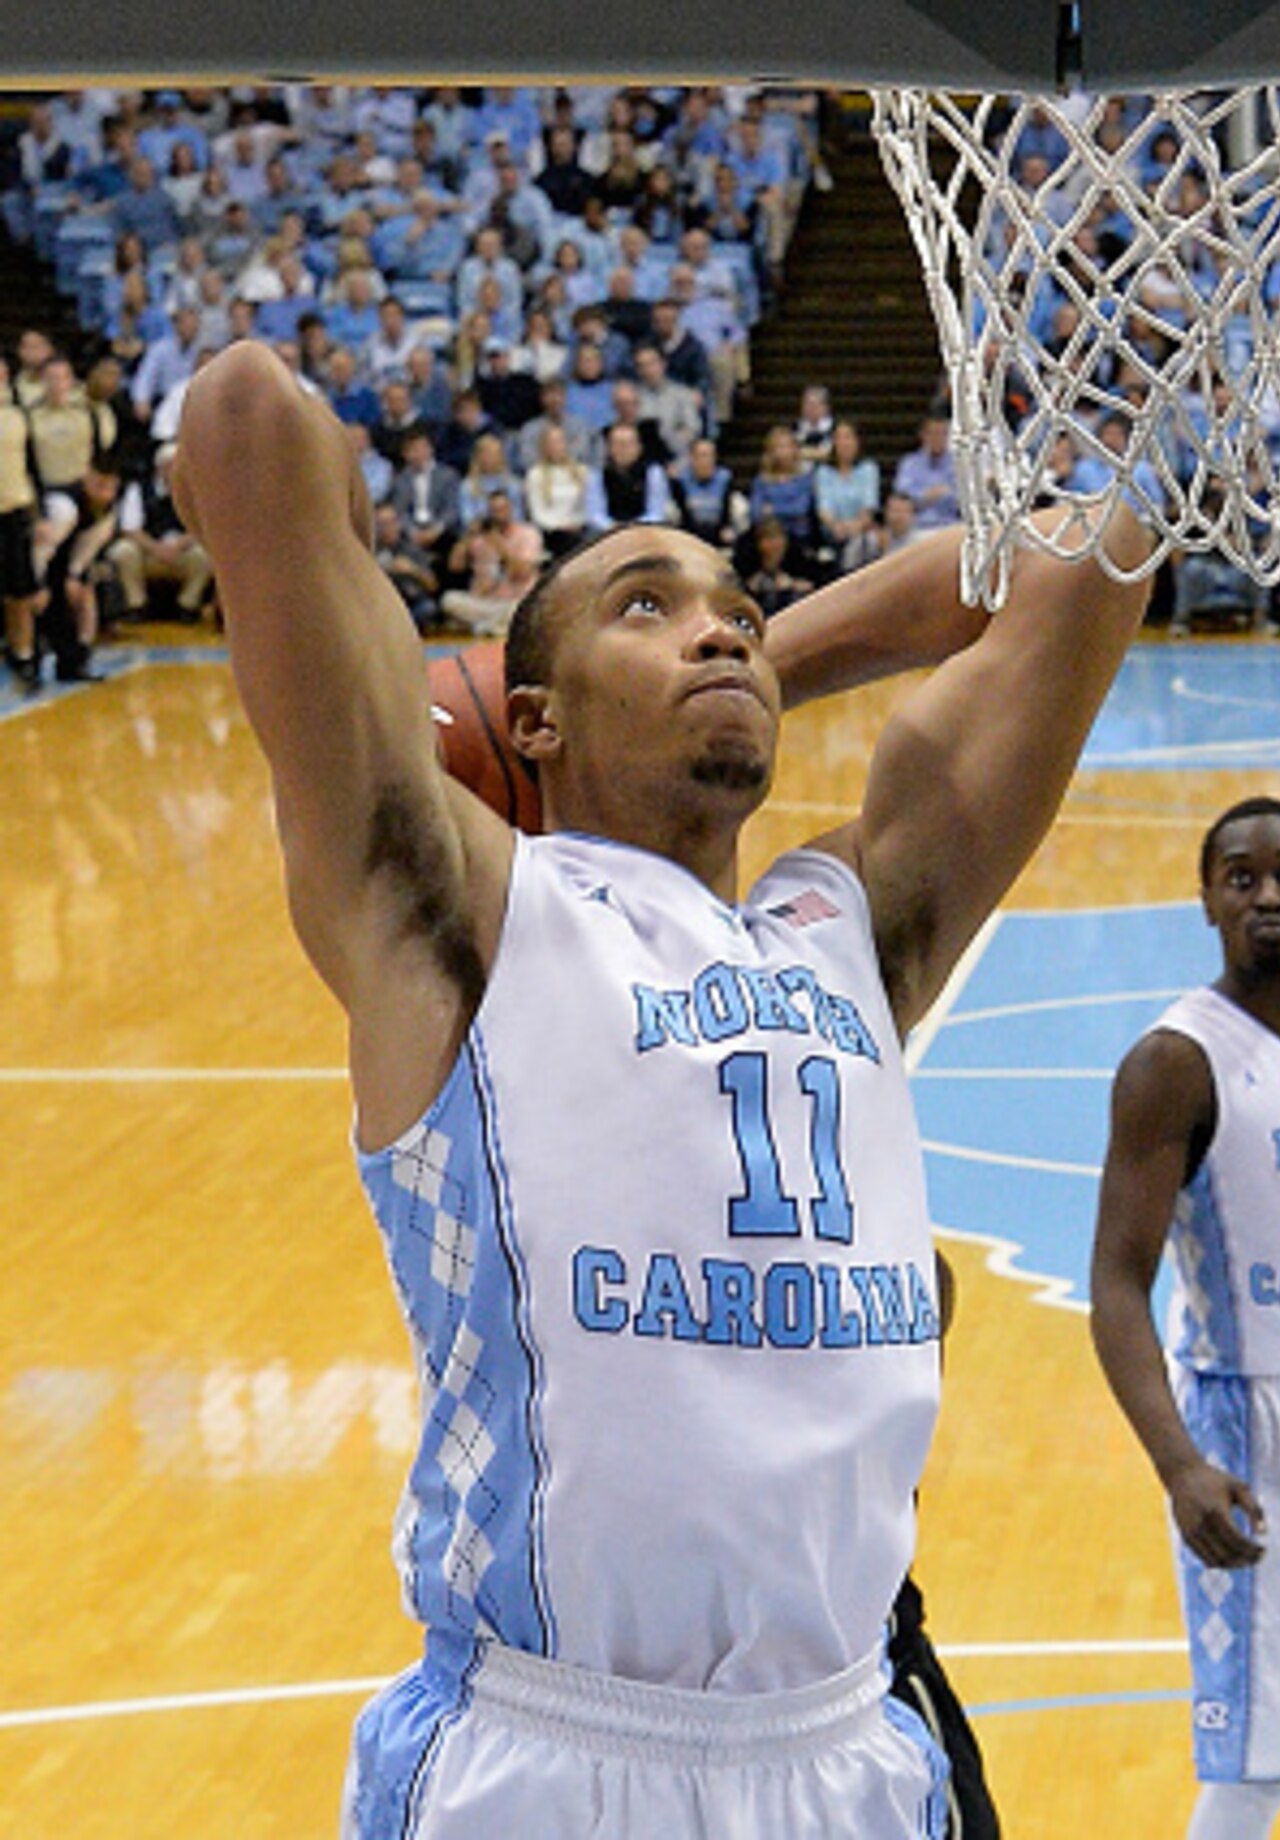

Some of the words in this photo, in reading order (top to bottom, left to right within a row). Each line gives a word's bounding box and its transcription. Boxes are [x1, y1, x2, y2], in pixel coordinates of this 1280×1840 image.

[631, 961, 881, 1066] NORTH
[718, 1050, 855, 1246] 11
[572, 1245, 940, 1349] CAROLINA
